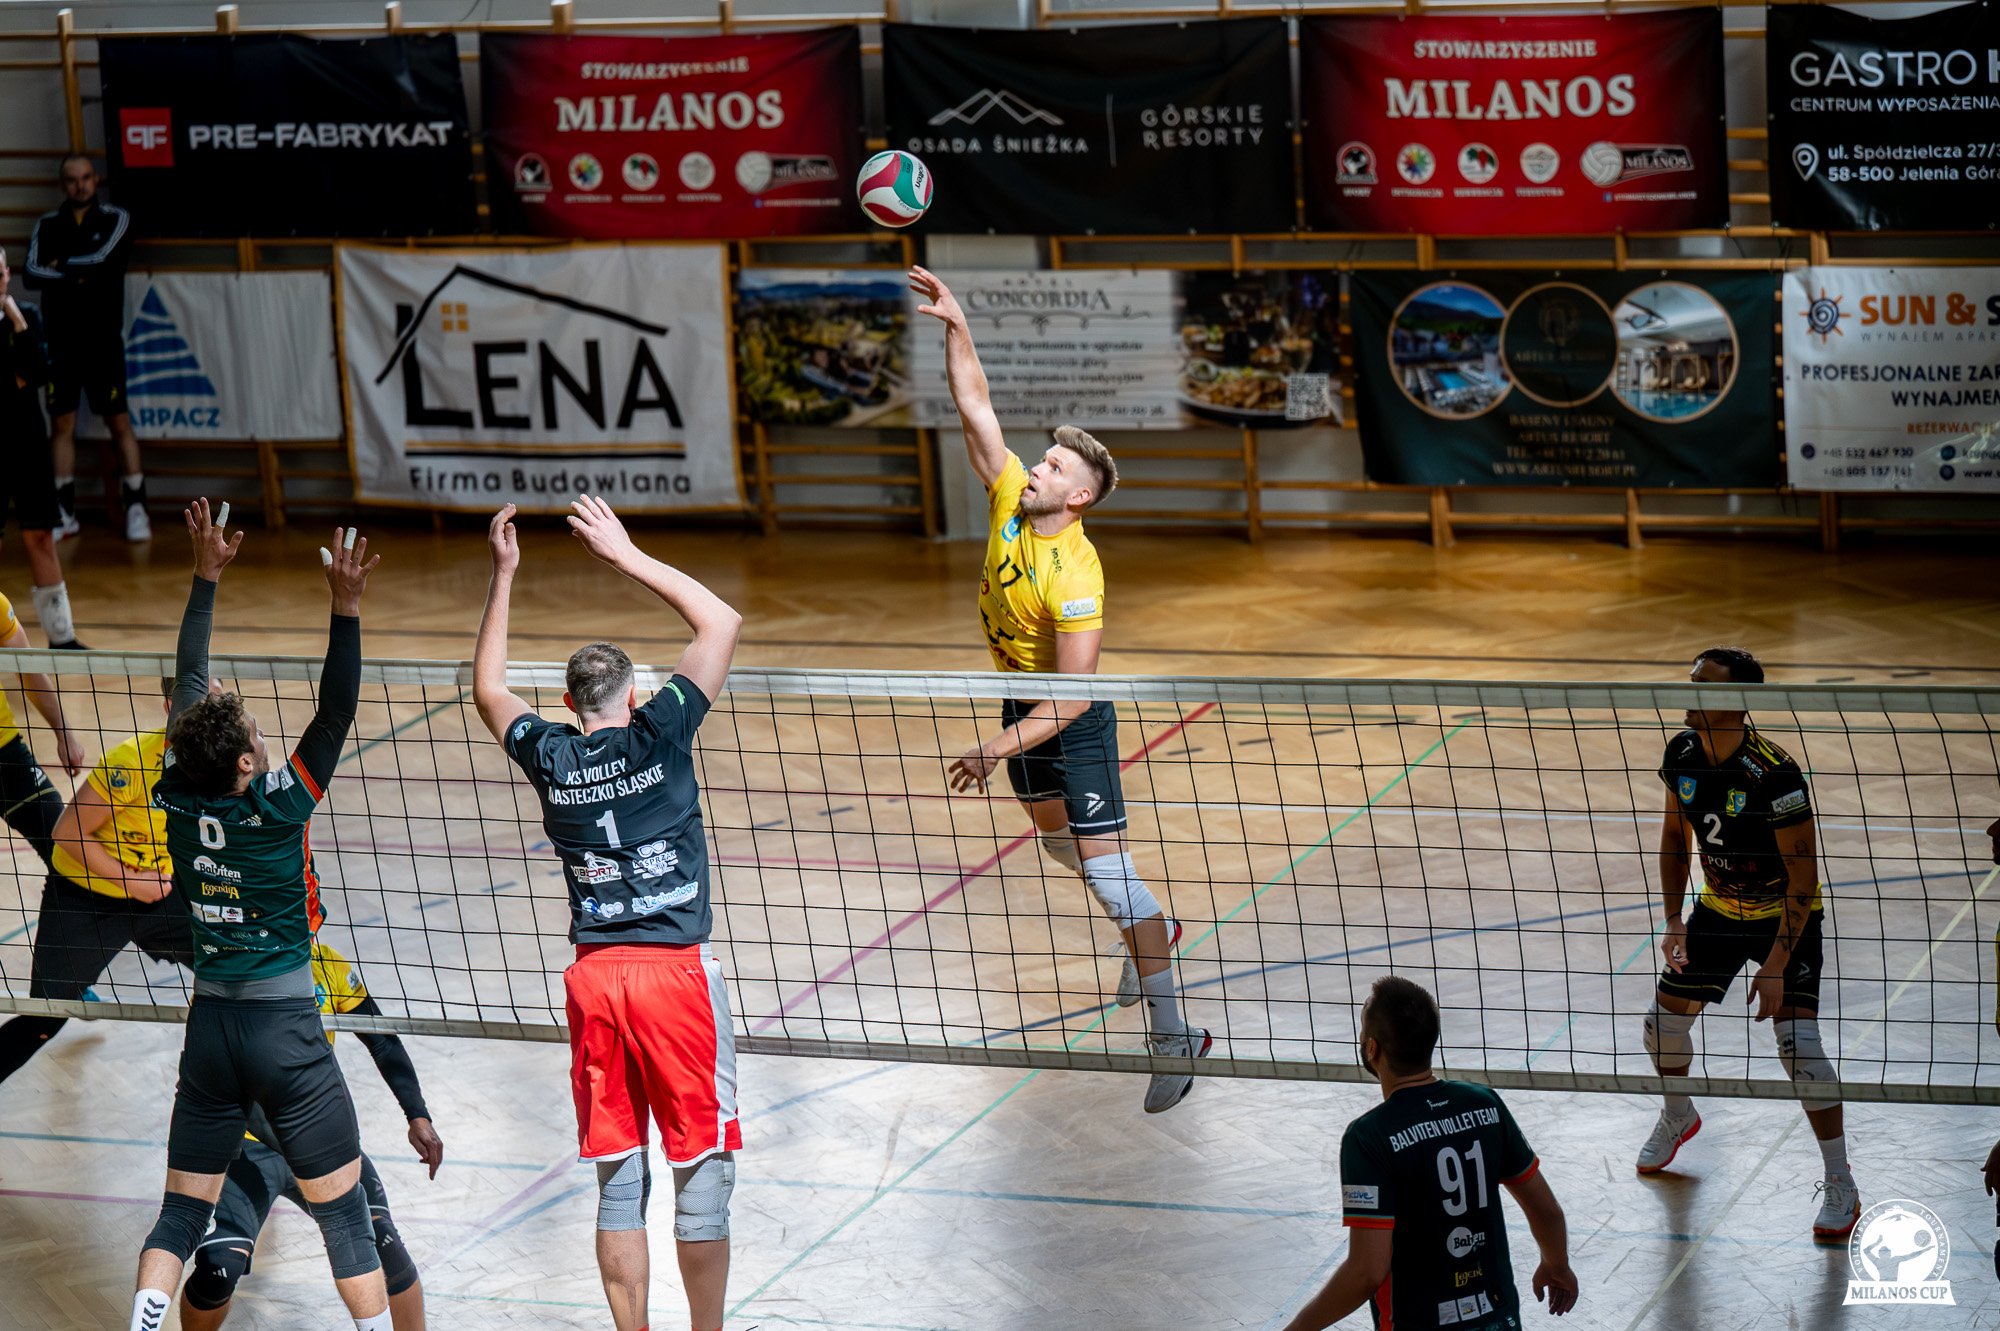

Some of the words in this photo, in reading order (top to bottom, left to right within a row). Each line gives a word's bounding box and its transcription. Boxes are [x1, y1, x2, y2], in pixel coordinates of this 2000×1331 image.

[1414, 40, 1597, 59] STOWARZYSZENIE
[1790, 49, 1977, 87] GASTRO
[554, 89, 785, 132] MILANOS
[1384, 74, 1636, 120] MILANOS
[1790, 97, 1872, 112] CENTRUM
[1140, 103, 1264, 128] GÓRSKIE
[188, 121, 453, 149] PRE-FABRYKAT
[908, 137, 982, 154] OSADA
[993, 134, 1090, 154] ŚNIEŻKA
[1143, 127, 1264, 150] RESORTY
[1828, 145, 1850, 160] ul.
[1828, 166, 1896, 182] 58-500
[1899, 165, 1960, 181] Jelenia
[1859, 294, 1936, 326] SUN
[1945, 292, 1977, 327] &
[396, 303, 684, 431] LENA
[1801, 364, 1962, 382] PROFESJONALNE
[127, 407, 220, 428] ARPACZ
[410, 467, 501, 491] Firma
[512, 466, 692, 494] Budowlana
[565, 770, 582, 785] KS
[583, 757, 626, 784] VOLLEY
[616, 763, 665, 797] ŚLĄSKIE
[595, 809, 622, 848] 1
[1703, 813, 1724, 846] 2
[1390, 1120, 1442, 1152] BALVITEN
[1438, 1111, 1477, 1136] VOLLEY
[1476, 1107, 1500, 1125] TEAM
[1436, 1139, 1488, 1217] 91
